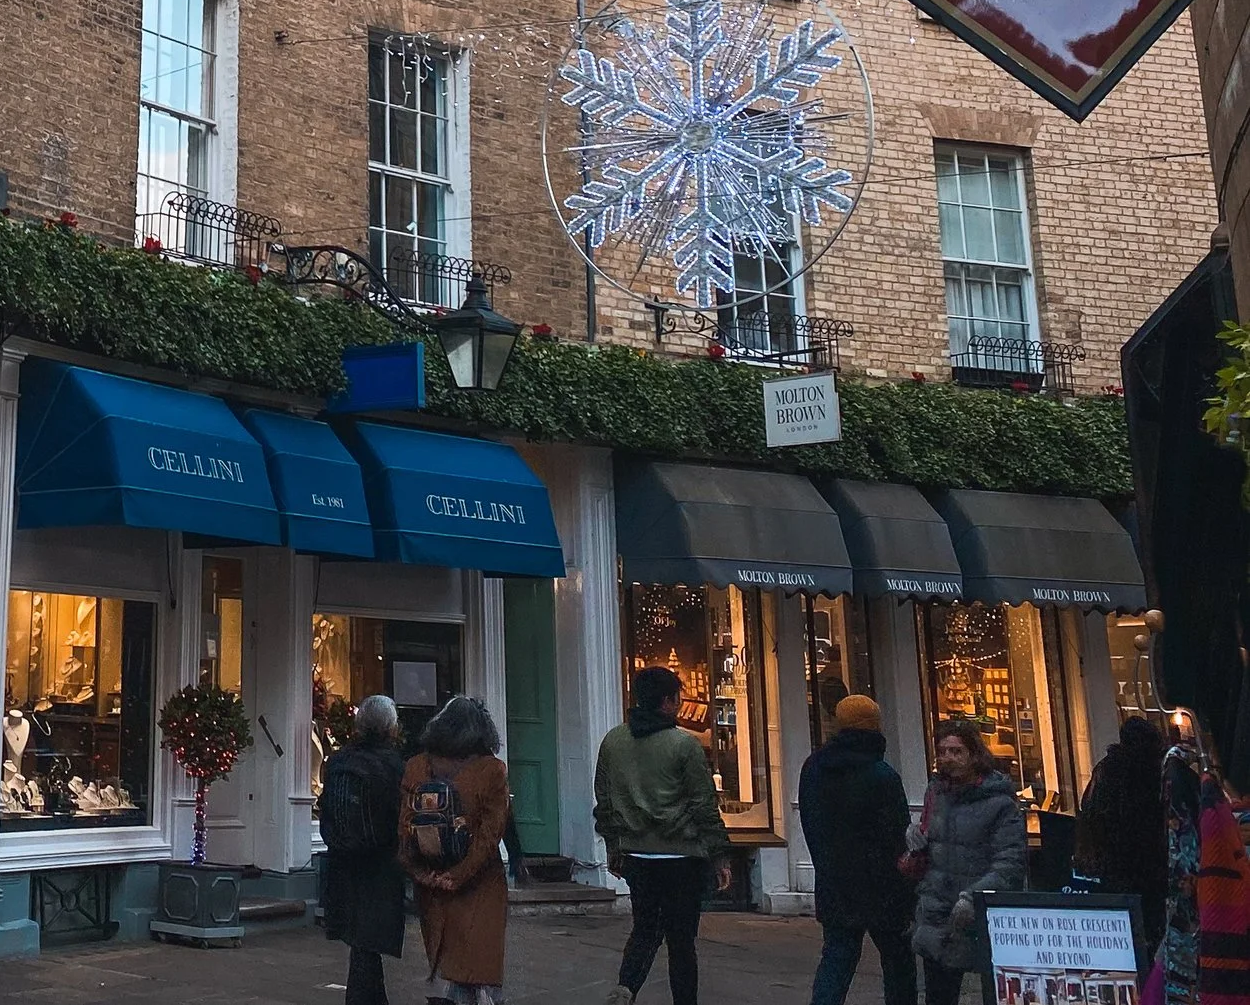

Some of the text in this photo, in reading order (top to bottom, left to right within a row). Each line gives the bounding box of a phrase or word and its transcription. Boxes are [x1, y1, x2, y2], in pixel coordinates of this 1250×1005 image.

[775, 385, 825, 406] MOLTON
[776, 404, 826, 425] BROWN
[786, 424, 818, 432] LONDON
[147, 446, 245, 483] CELLINI
[327, 496, 344, 509] 1981
[426, 494, 526, 525] CELLINI
[738, 569, 815, 586] MOLTON BROWN
[886, 578, 962, 594] MOLTON BROWN
[1032, 588, 1111, 602] MOLTON BROWN
[993, 916, 1017, 929] WE'RE
[1021, 917, 1038, 930] NEW
[1043, 917, 1054, 930] ON
[1057, 918, 1077, 931] ROSE
[994, 933, 1129, 950] POPPING UP FOR THE HOLIDAYS
